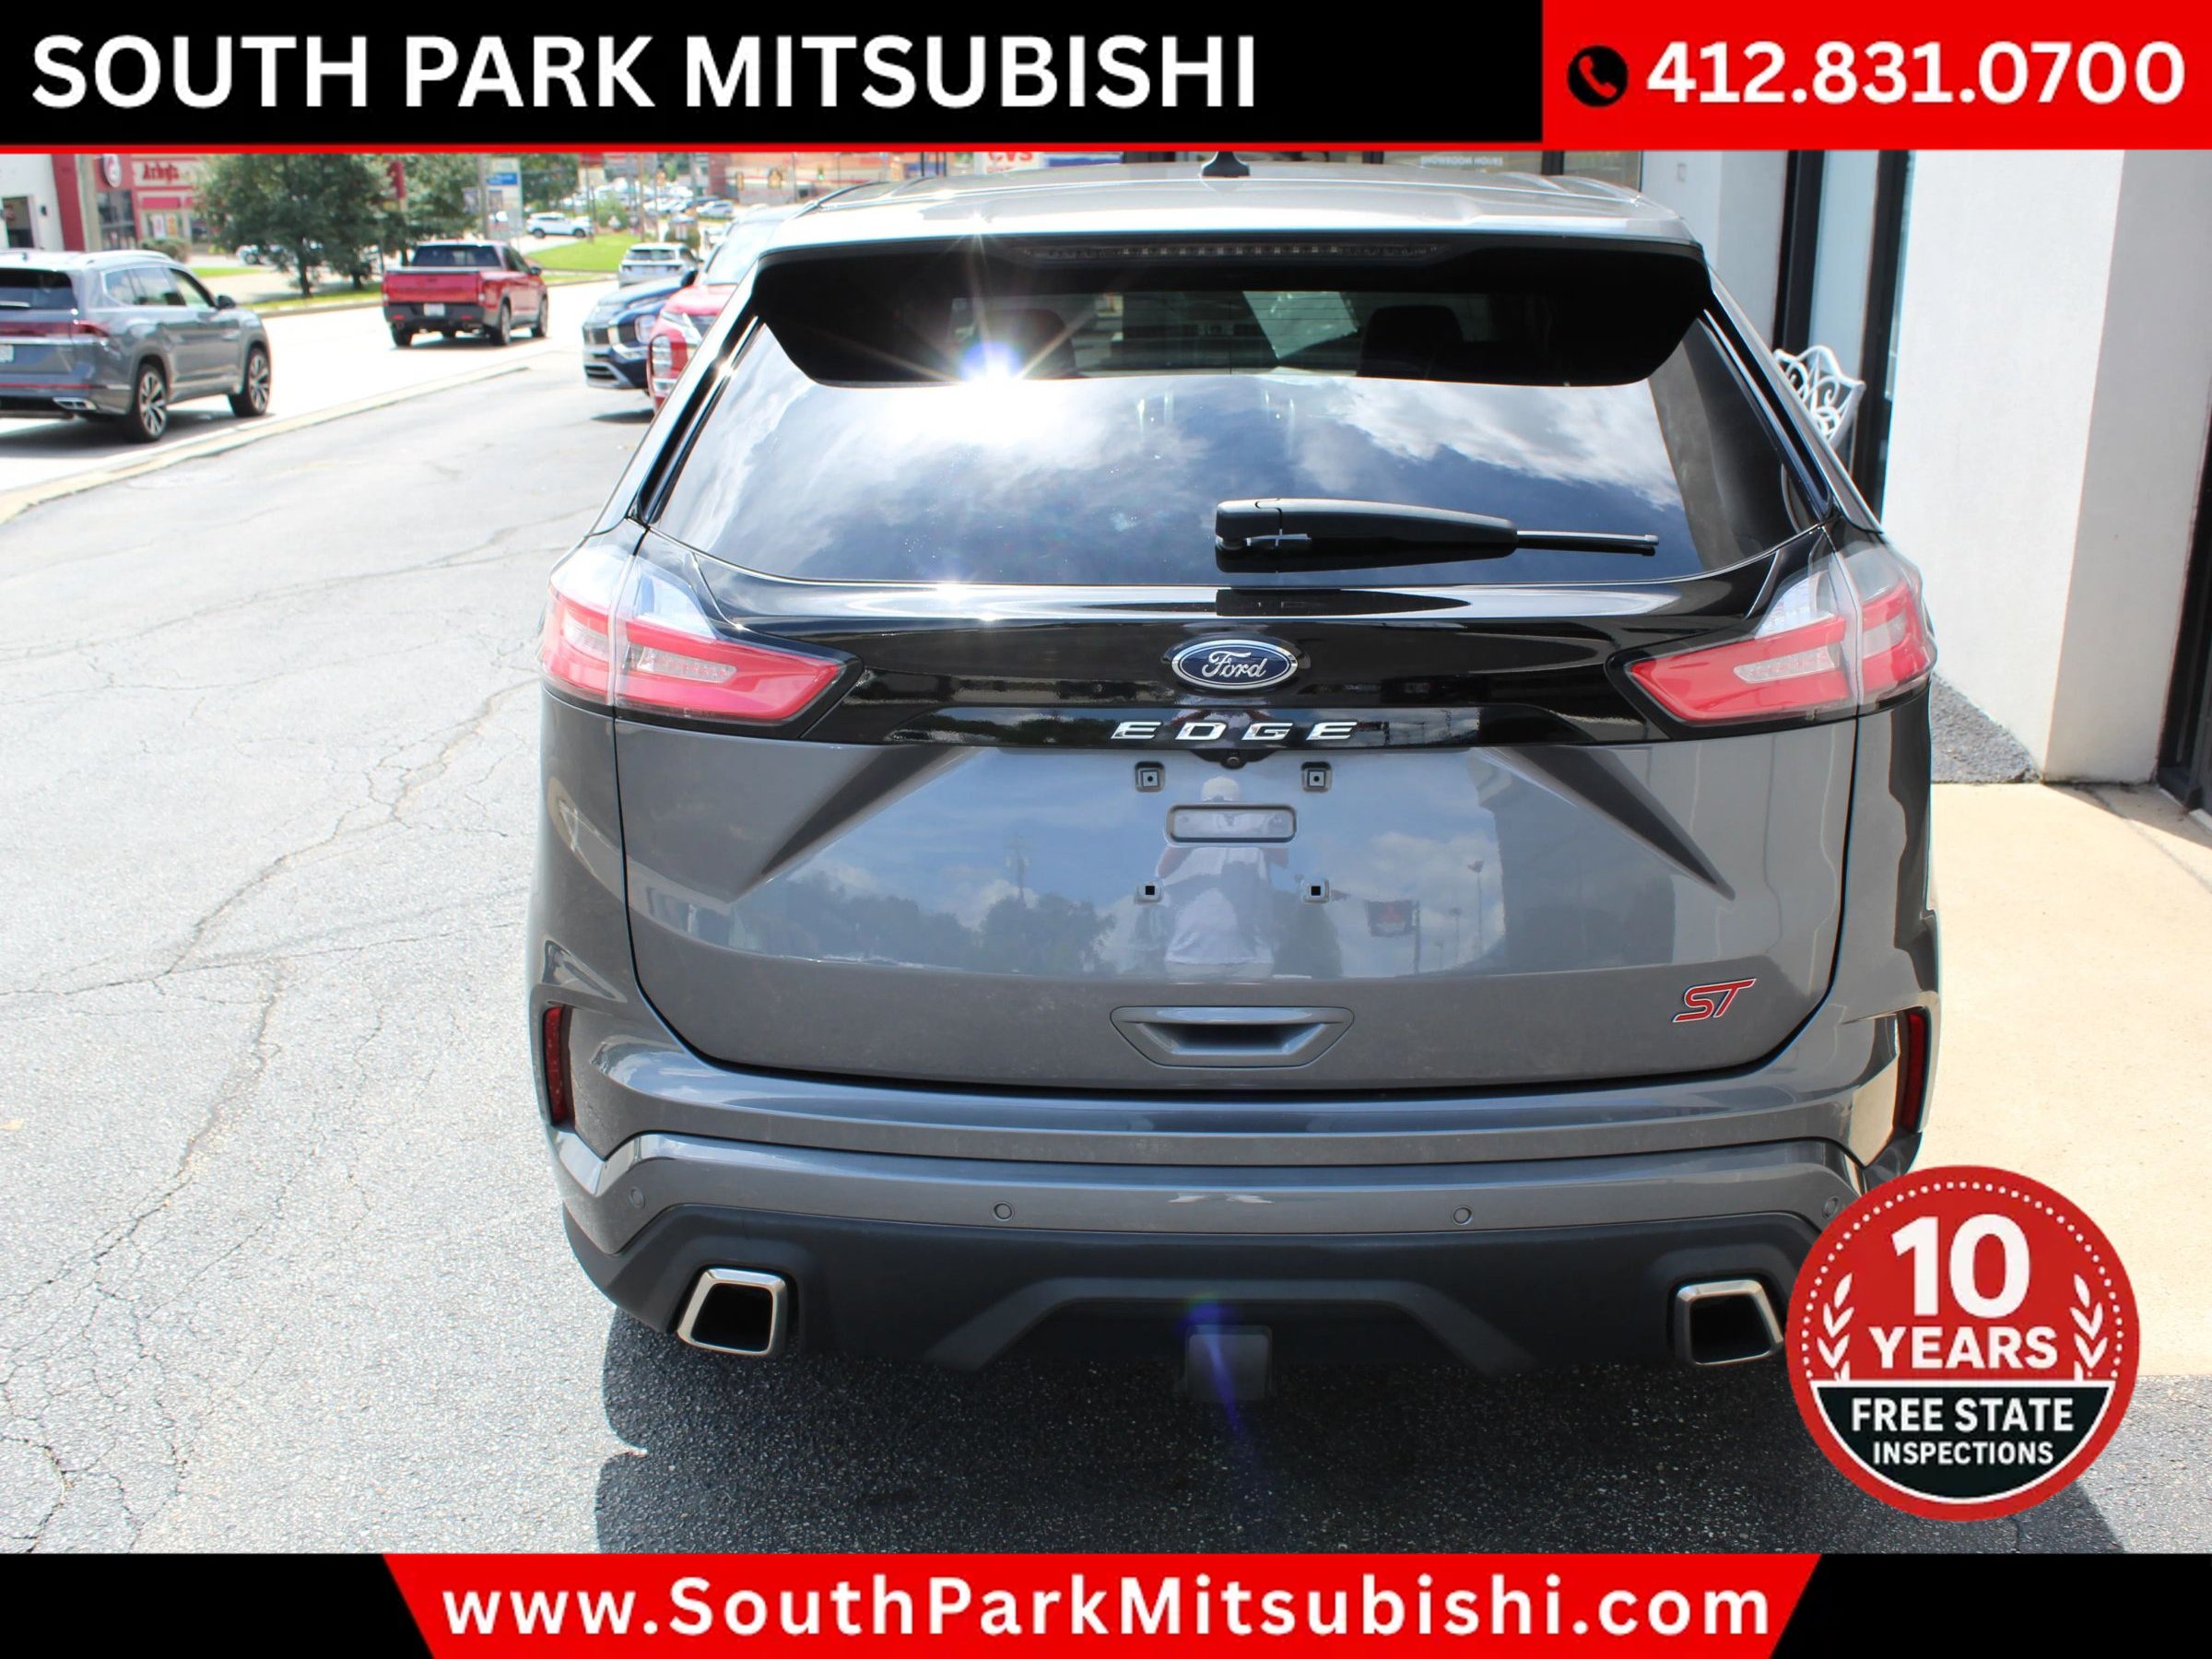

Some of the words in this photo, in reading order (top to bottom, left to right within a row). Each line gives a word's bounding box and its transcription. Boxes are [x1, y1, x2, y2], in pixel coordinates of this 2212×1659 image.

[1201, 650, 1268, 678] Ford
[1111, 721, 1358, 740] EDGE
[1672, 978, 1757, 1023] ST
